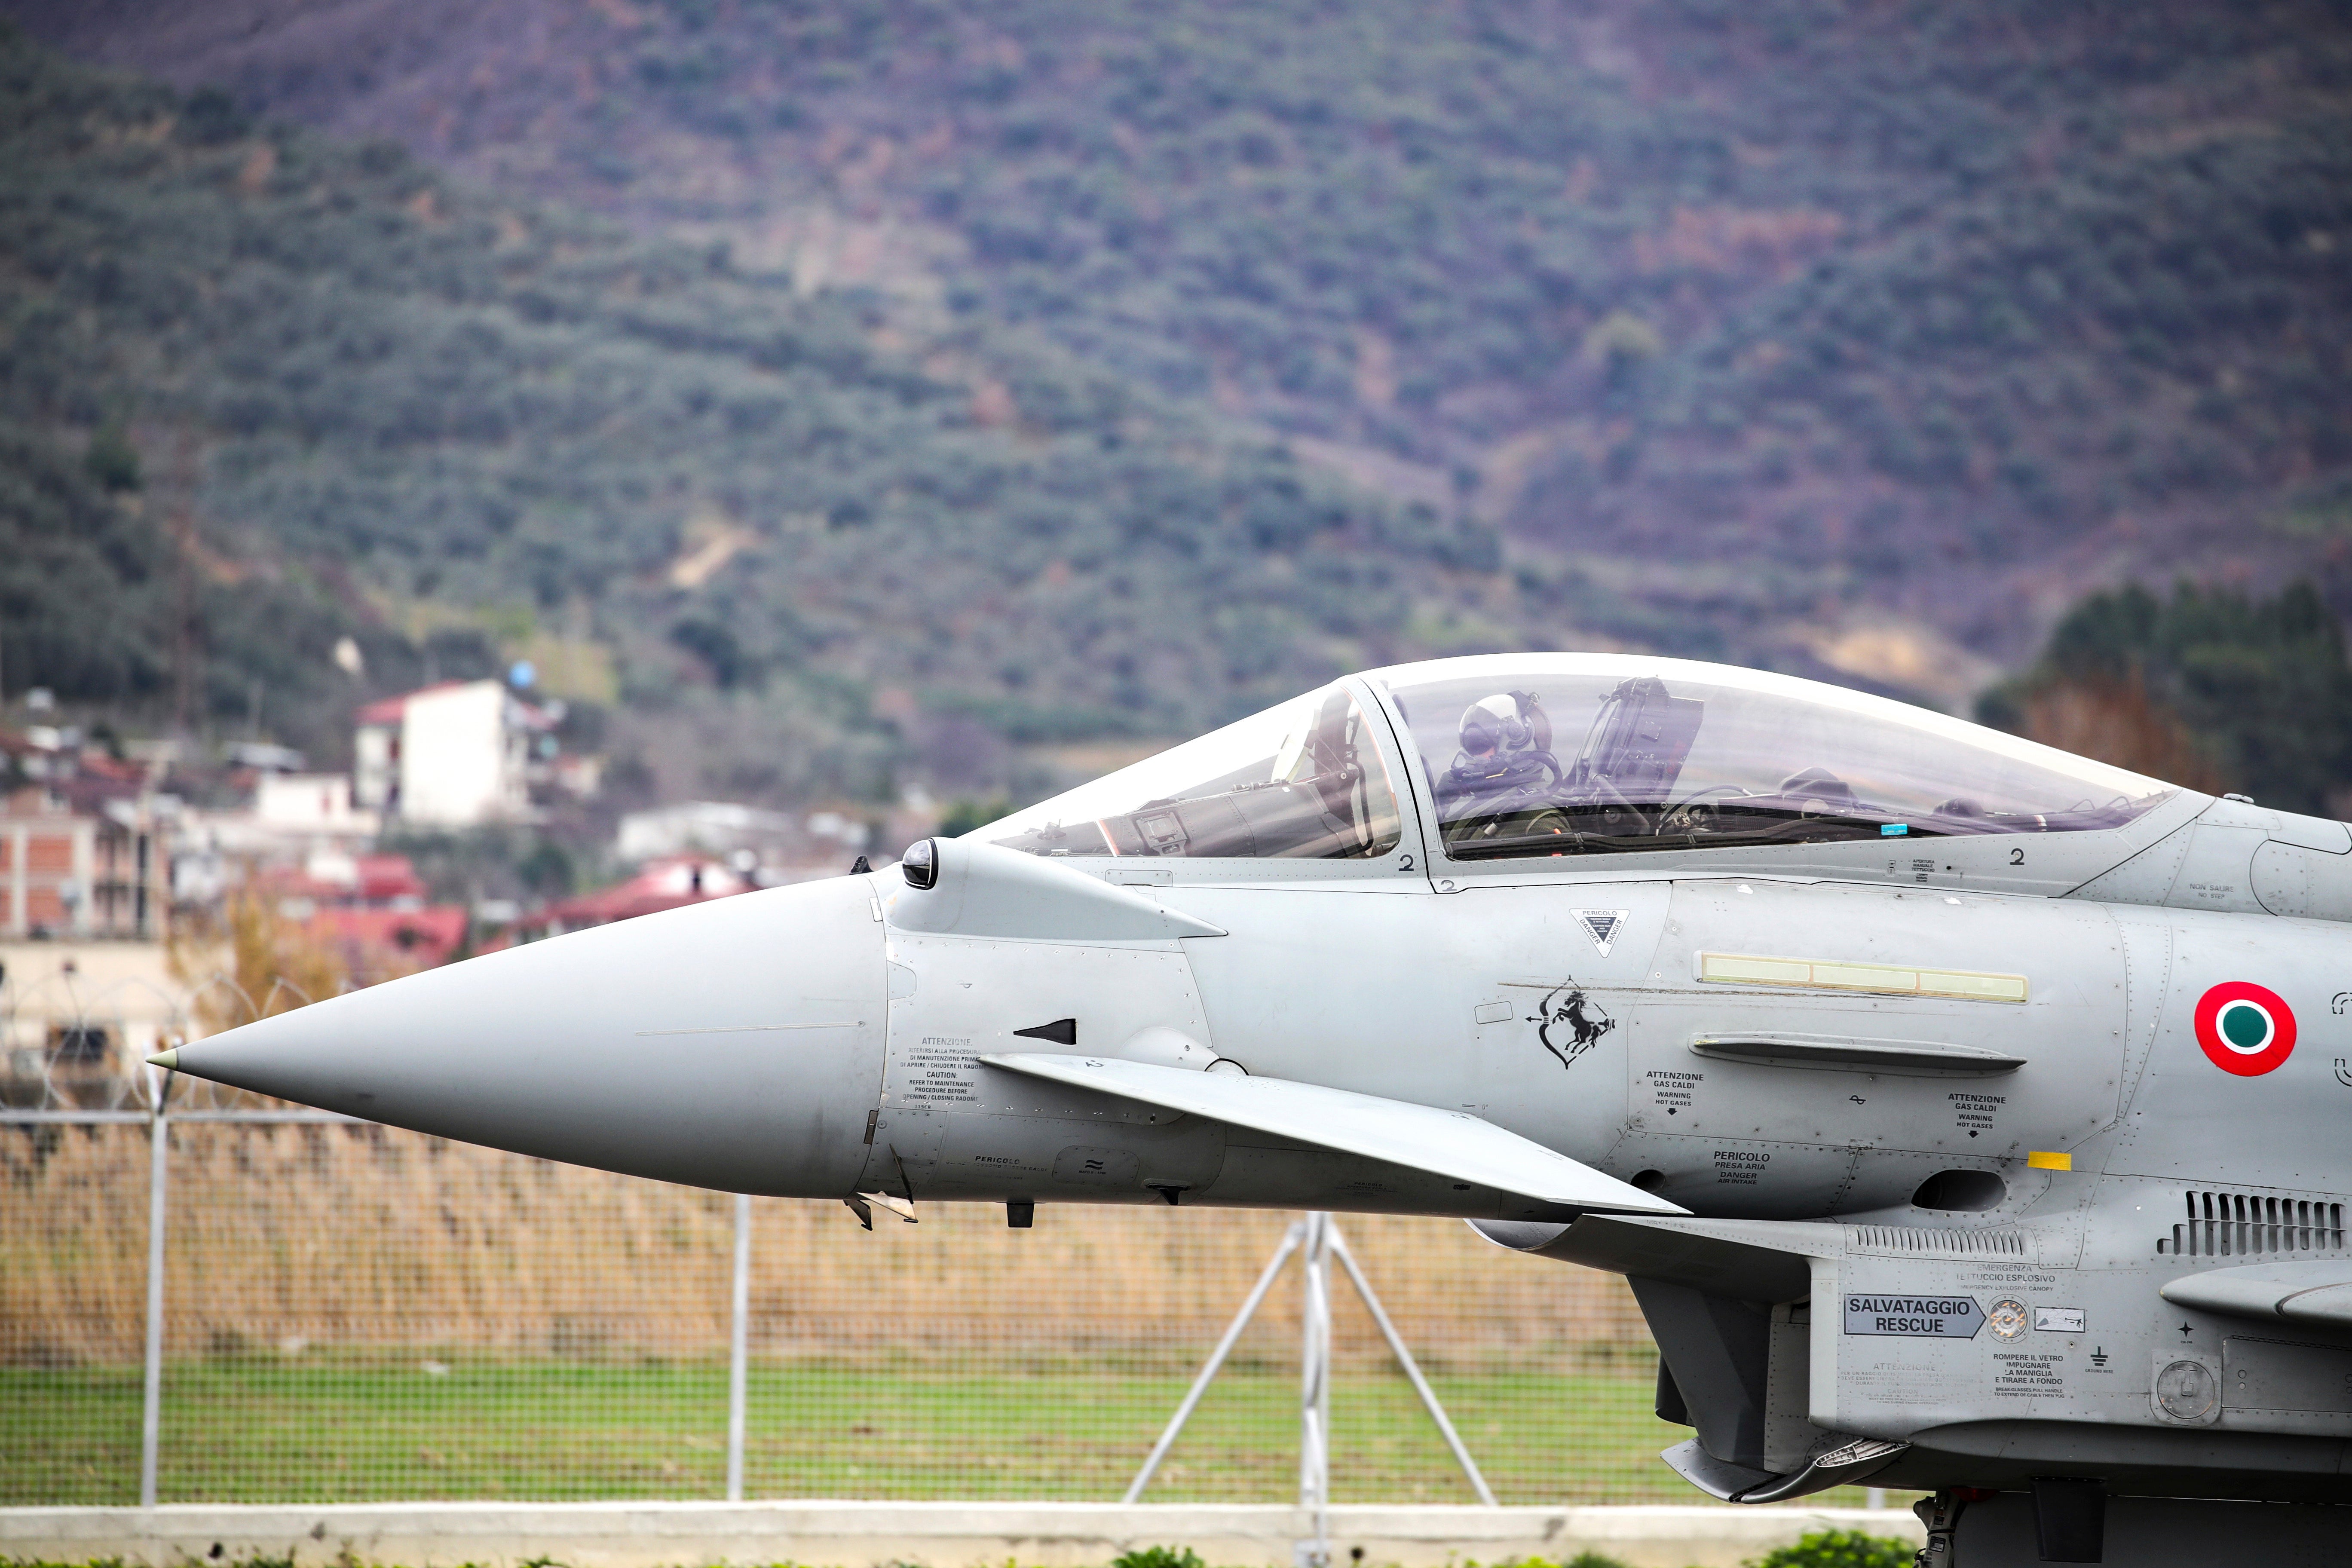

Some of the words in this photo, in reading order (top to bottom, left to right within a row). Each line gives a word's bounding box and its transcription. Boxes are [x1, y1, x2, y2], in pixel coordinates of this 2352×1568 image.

[1399, 854, 1414, 871] 2
[2009, 848, 2024, 865] 2
[1441, 880, 1457, 891] 2
[1580, 919, 1600, 944] DANGER
[1607, 920, 1623, 945] DANGER
[1646, 1071, 1704, 1081] ATTENZIONE
[1948, 1093, 2006, 1104] ATTENZIONE
[975, 1156, 1020, 1164] PERICOLO
[1714, 1151, 1770, 1162] PERICOLO
[1849, 1298, 1970, 1315] SALVATAGGIO
[1876, 1317, 1944, 1332] RESCUE
[1873, 1363, 1936, 1371] ATTENZIONE
